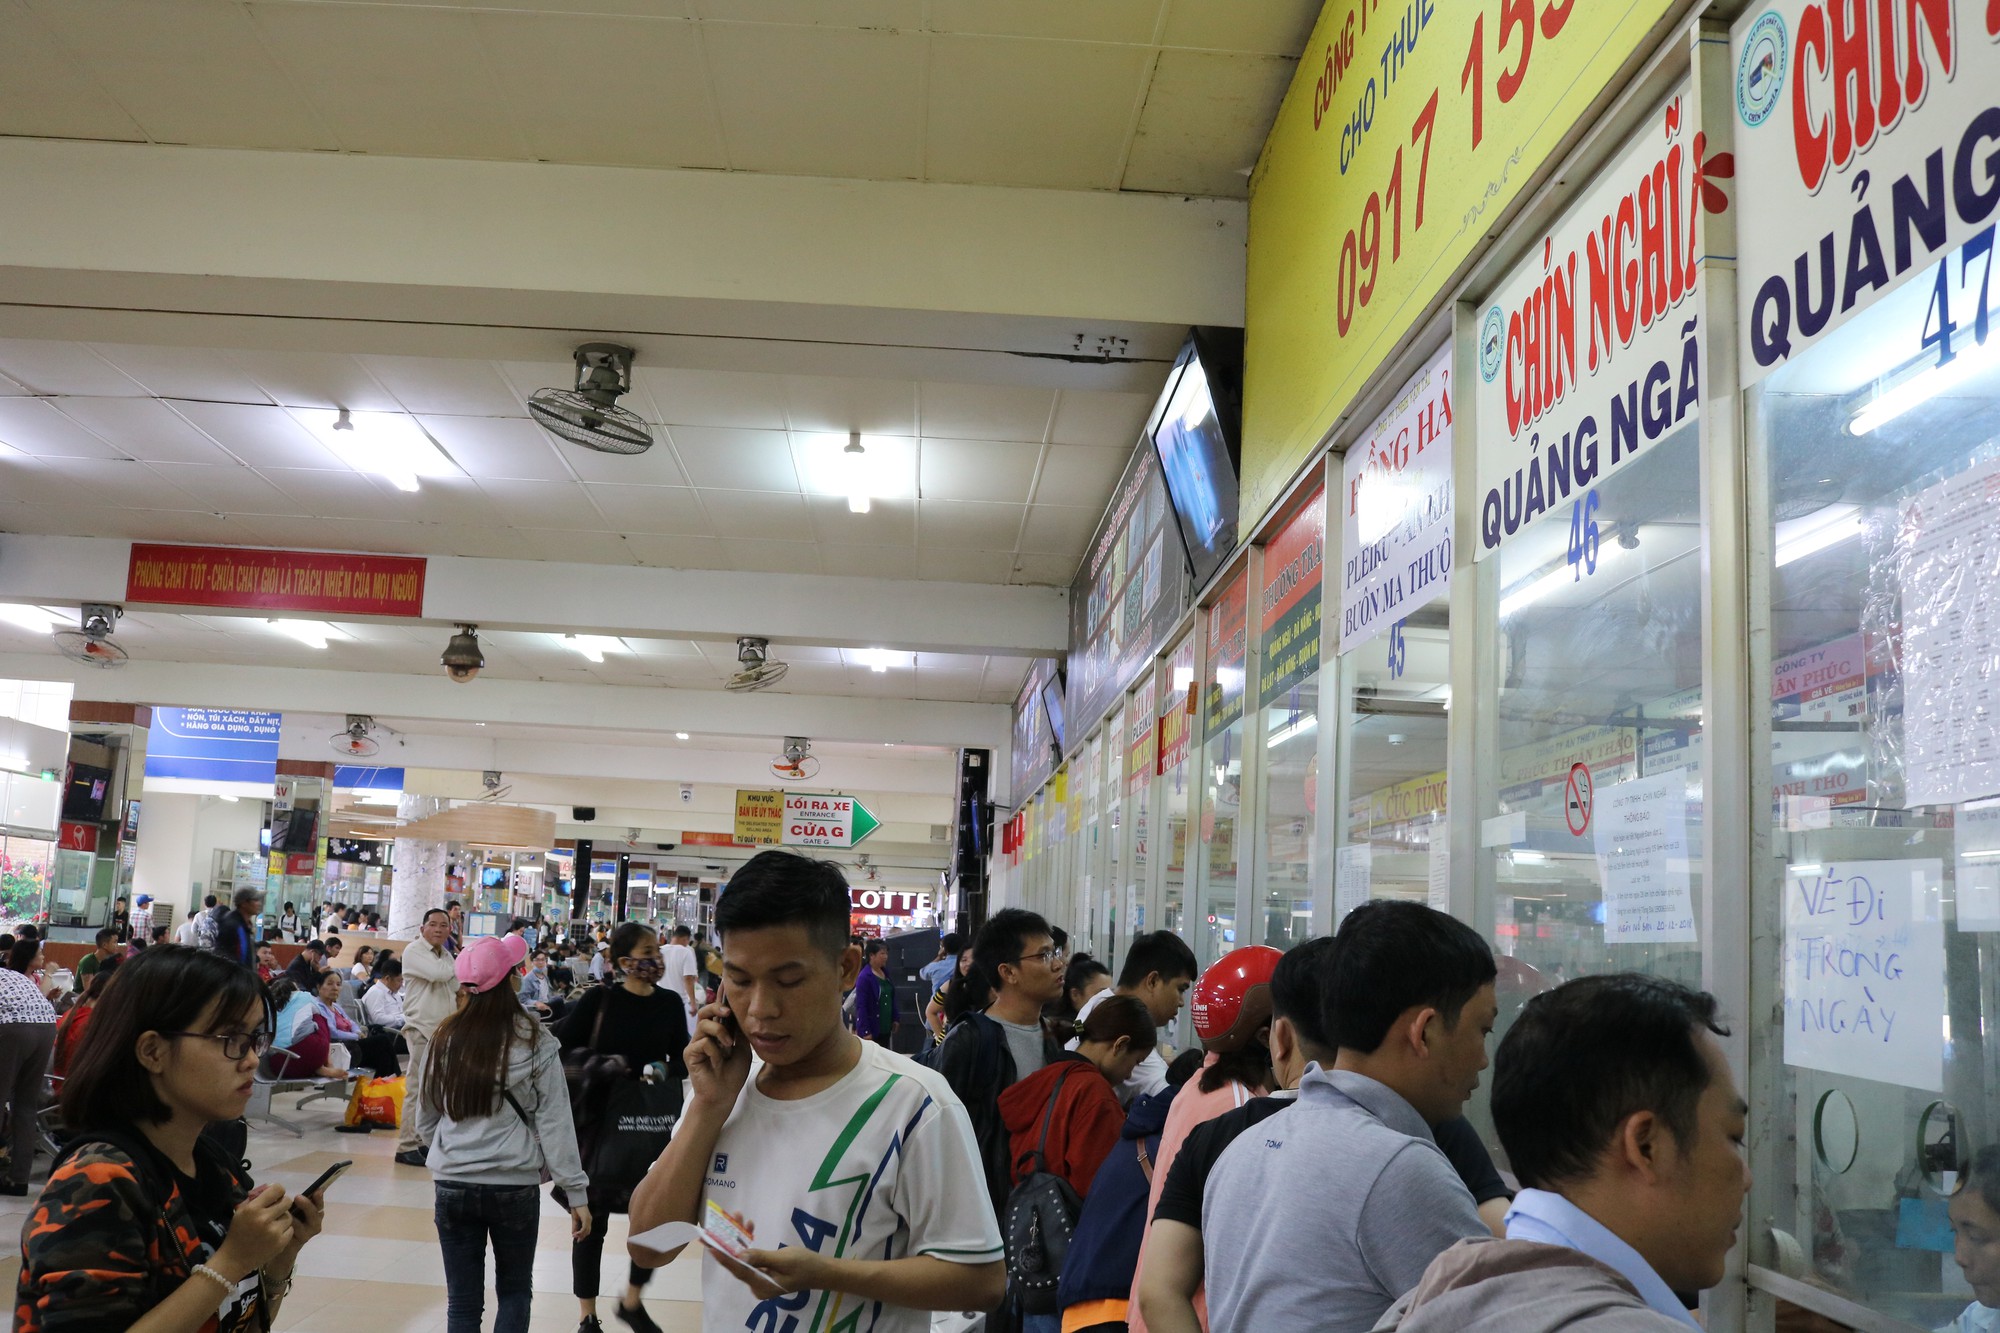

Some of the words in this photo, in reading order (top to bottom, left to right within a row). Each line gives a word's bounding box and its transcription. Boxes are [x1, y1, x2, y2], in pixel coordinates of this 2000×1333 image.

[1314, 9, 1355, 131] CÔNG
[1340, 77, 1376, 176] CHO
[1337, 86, 1439, 338] 0917
[1751, 106, 2000, 367] QUẢNG
[1921, 222, 1998, 369] 47
[1504, 234, 1579, 441] CHÍN
[1482, 416, 1599, 549] QUẢNG
[1567, 489, 1600, 582] 46
[134, 555, 165, 589] PHÒNG
[165, 557, 193, 590] CHÁY
[191, 555, 207, 590] TỐT
[211, 557, 235, 592] CHỮA
[236, 560, 259, 594] CHÁY
[260, 557, 279, 594] GIỎI
[279, 563, 293, 596] LÀ
[294, 563, 321, 597] TRÁCH
[322, 565, 353, 602] NHIỆM
[353, 563, 370, 599] CỦA
[372, 571, 390, 606] MỌI
[391, 568, 418, 602] NGƯỜI
[1344, 587, 1380, 639] BUÔN
[1380, 573, 1404, 616] MA
[1388, 617, 1408, 681] 45
[1774, 657, 1807, 676] CÔNG
[1810, 650, 1827, 664] TY
[1770, 674, 1798, 697] ÂN
[1802, 660, 1852, 688] PHÚC
[186, 713, 206, 722] NÓN,
[208, 714, 221, 722] TÚI
[222, 714, 248, 724] XÁCH,
[249, 715, 266, 725] DÂY
[186, 722, 209, 730] HÀNG
[211, 723, 226, 731] GIA
[227, 725, 252, 734] DỤNG,
[253, 726, 277, 735] DỤNG
[738, 804, 751, 818] BÁN
[750, 804, 759, 818] VÉ
[767, 806, 782, 819] THÁC
[747, 794, 761, 802] KHU
[761, 795, 775, 804] VỰC
[786, 797, 808, 810] LỐI
[811, 801, 829, 811] RA
[833, 802, 851, 811] XE
[800, 811, 836, 819] ENTRANCE
[790, 822, 828, 838] CỬA
[831, 826, 844, 838] G
[823, 838, 830, 846] G
[848, 890, 933, 911] LOTTE
[1798, 866, 1844, 917] VÉ
[1846, 875, 1885, 927] Đi
[1801, 936, 1905, 981] TRONG
[1801, 986, 1897, 1043] NGÀY
